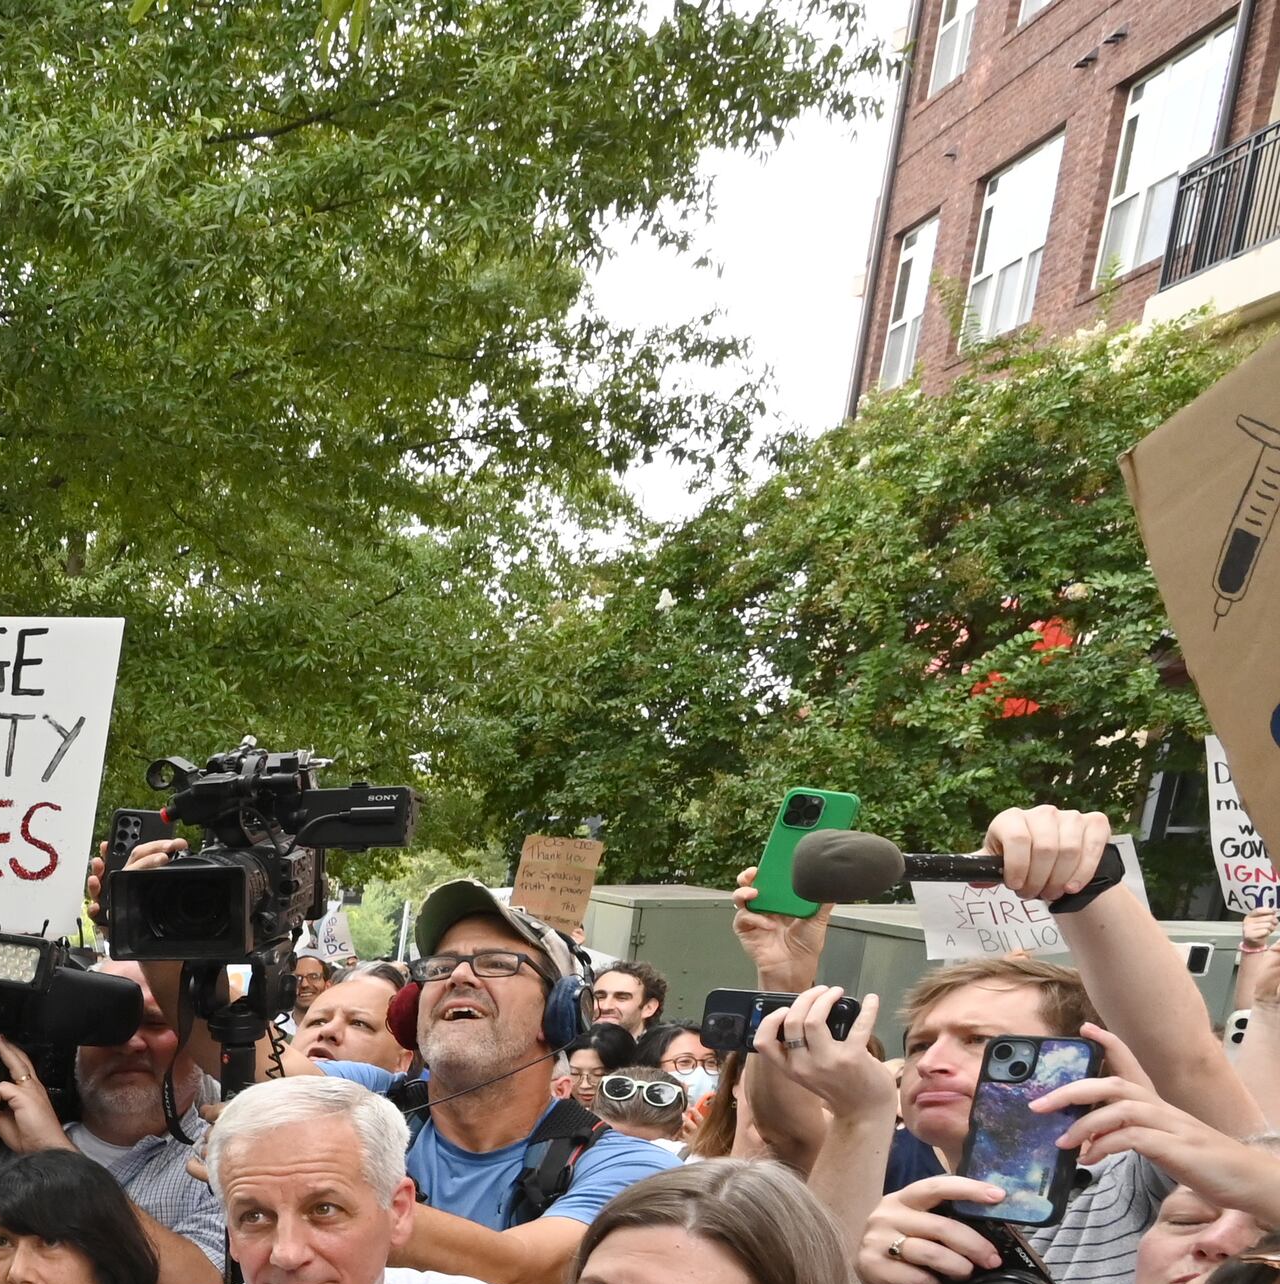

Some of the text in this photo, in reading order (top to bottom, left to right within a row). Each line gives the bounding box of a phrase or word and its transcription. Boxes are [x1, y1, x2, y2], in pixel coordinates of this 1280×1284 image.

[367, 794, 399, 802] SONY
[526, 843, 561, 860] Thank
[966, 899, 1051, 925] FIRE
[945, 933, 956, 946] A
[1015, 1246, 1037, 1269] SONY
